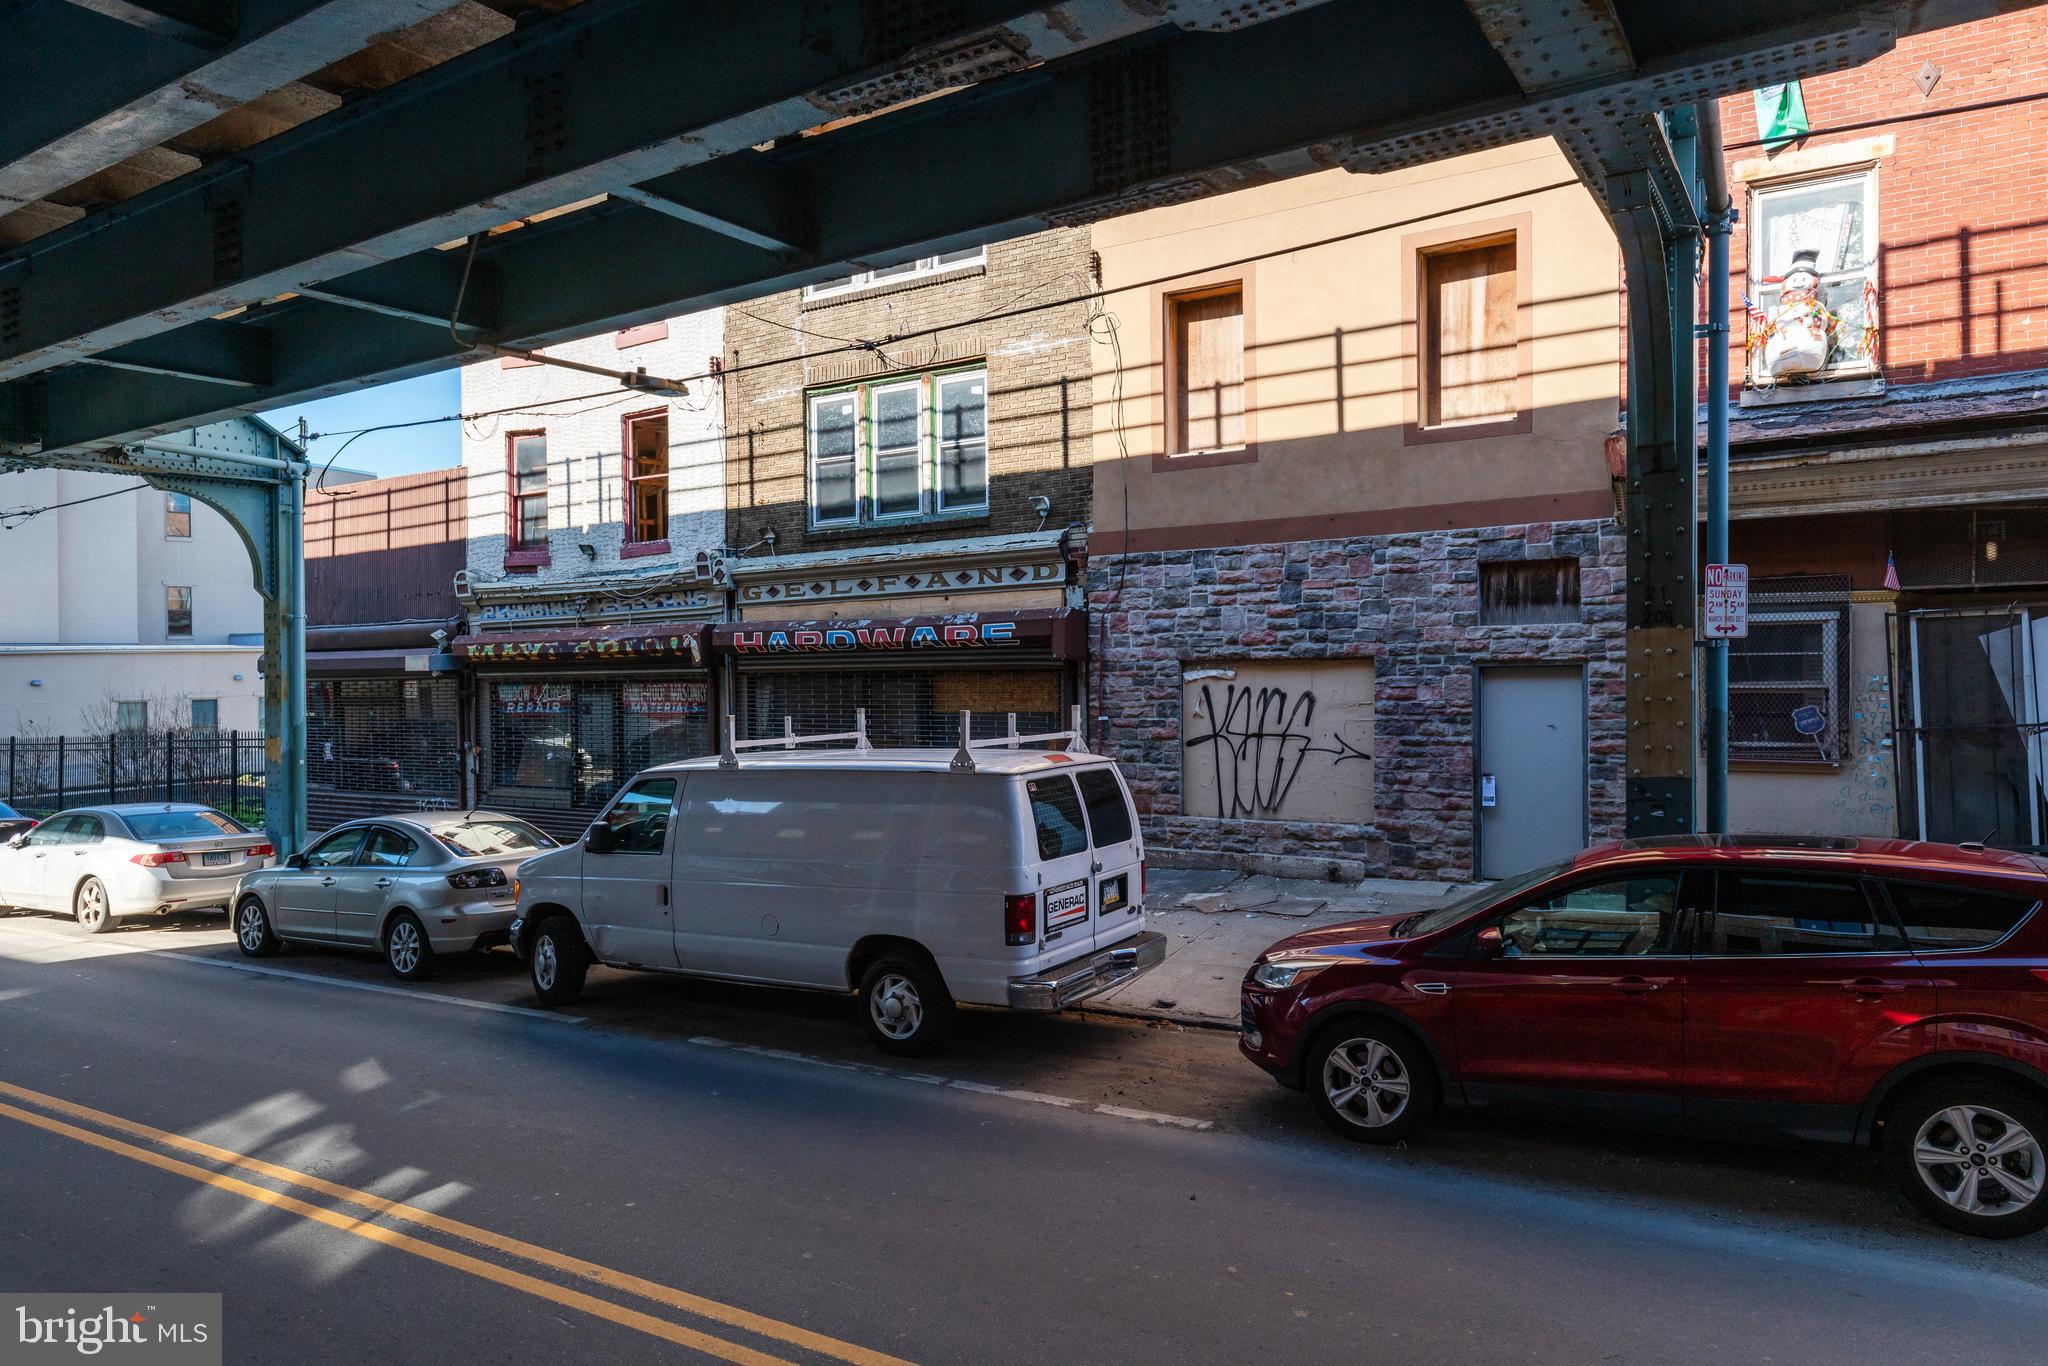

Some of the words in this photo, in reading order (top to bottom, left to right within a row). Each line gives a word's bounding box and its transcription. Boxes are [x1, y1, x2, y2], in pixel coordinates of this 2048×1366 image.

[742, 562, 1059, 600] GELFAND
[1707, 568, 1722, 585] NO
[1709, 589, 1743, 599] SUNDAY
[733, 621, 1020, 654] HARDWARE
[506, 702, 561, 713] REPAIR
[630, 702, 699, 713] MATERIALS
[1048, 893, 1085, 914] GENERAC
